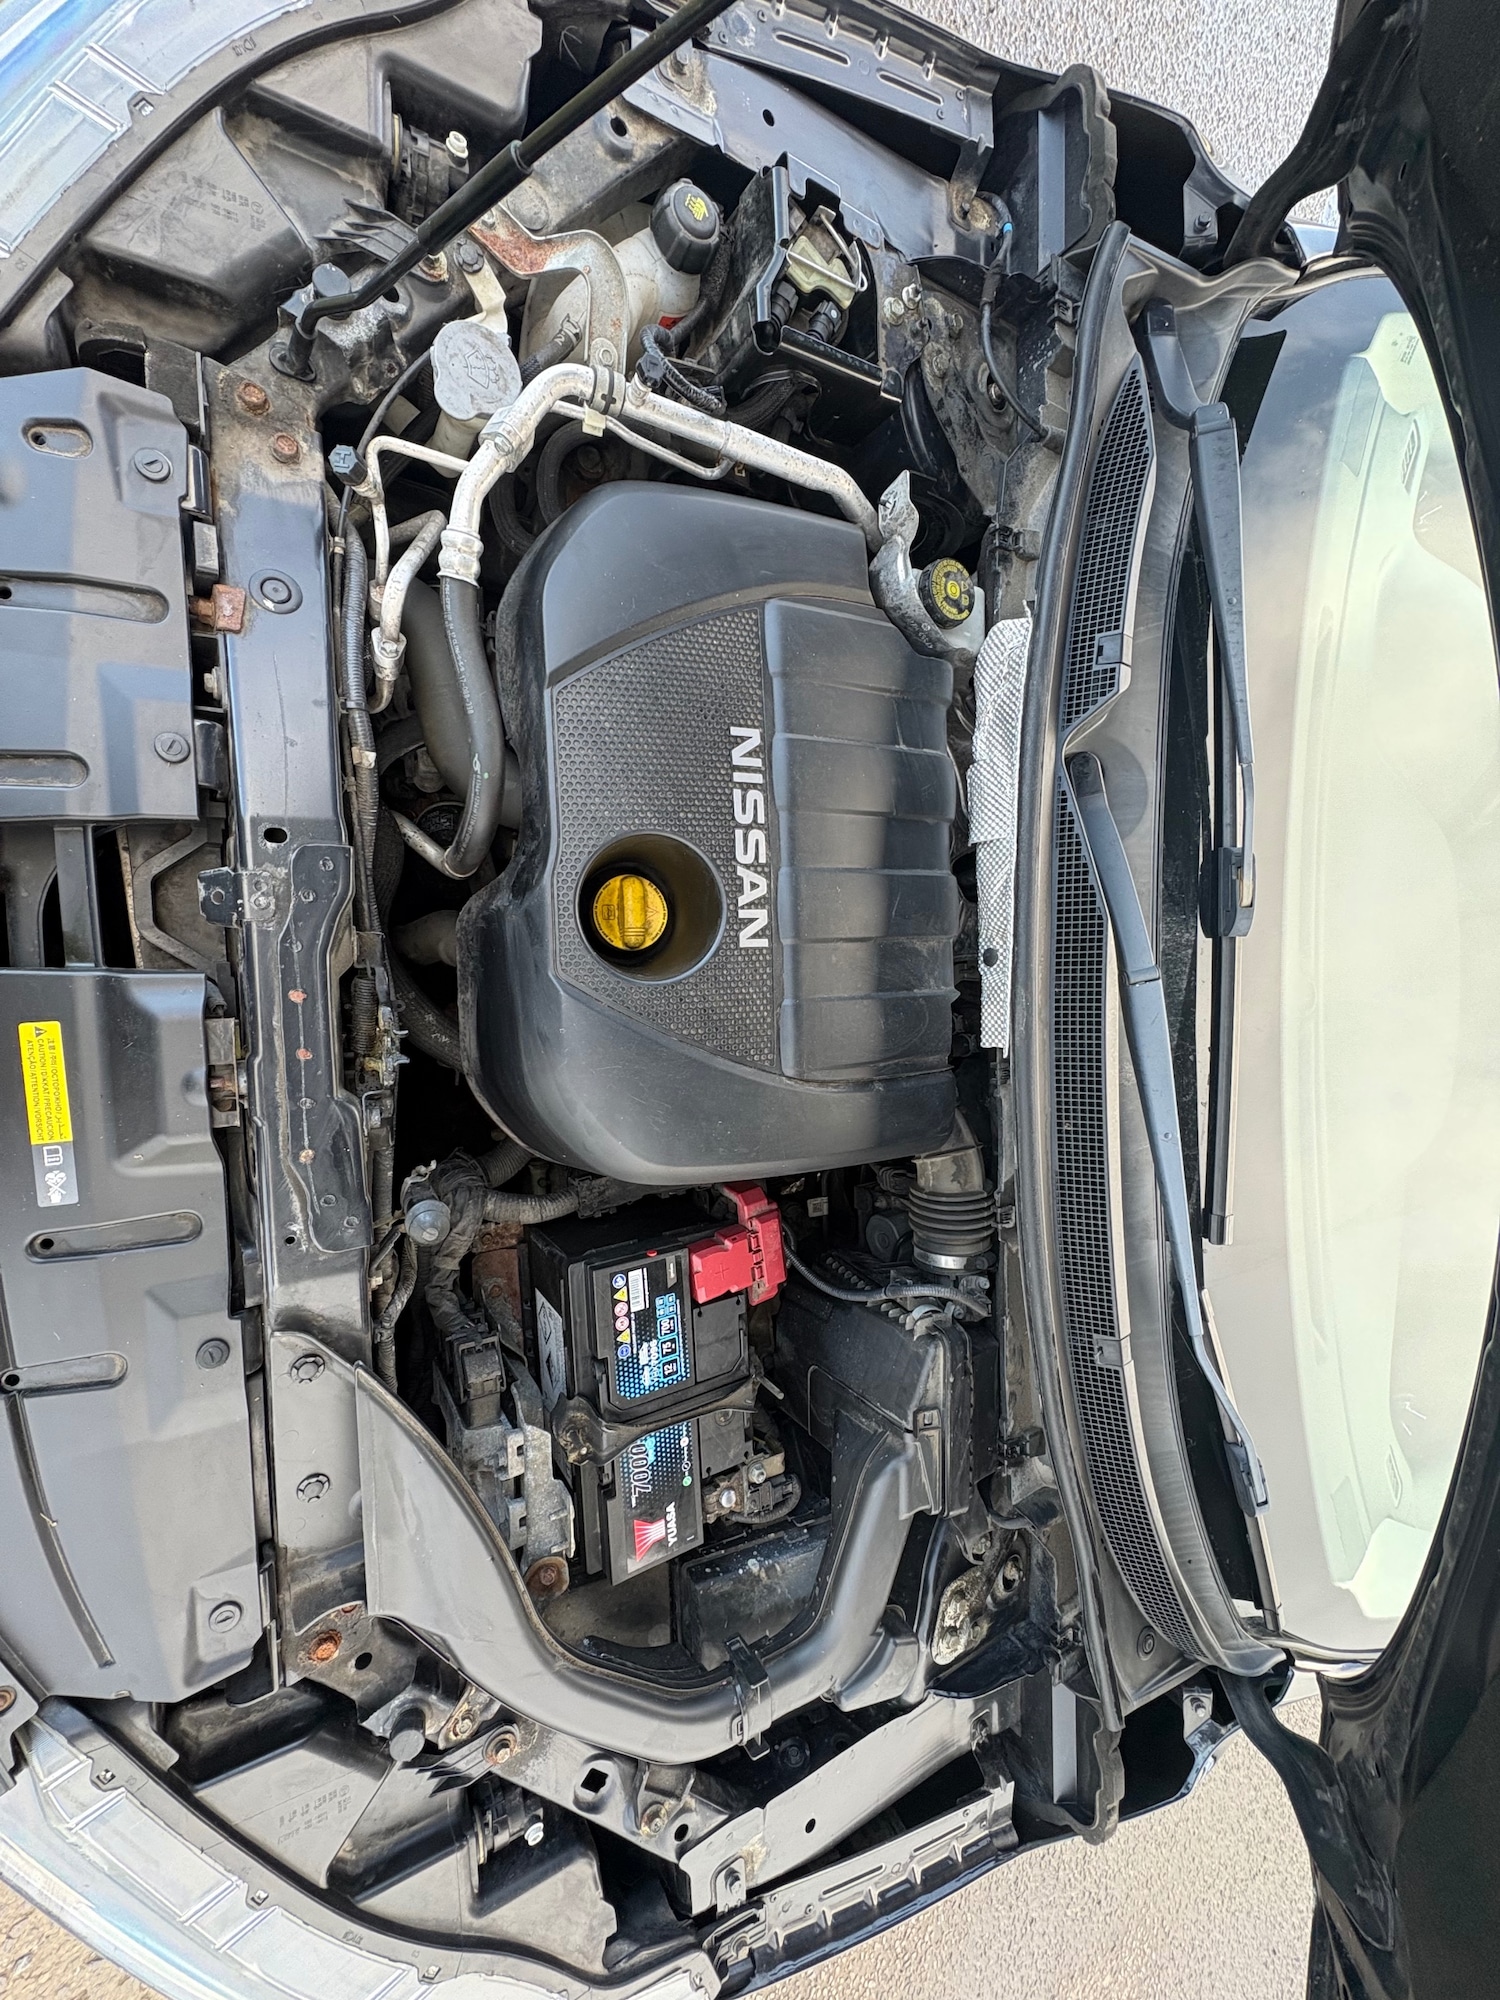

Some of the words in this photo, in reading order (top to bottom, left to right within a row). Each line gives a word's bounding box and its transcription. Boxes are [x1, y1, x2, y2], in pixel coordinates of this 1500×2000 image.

[730, 726, 769, 948] NISSAN
[660, 1318, 670, 1336] 700
[662, 1341, 671, 1355] 75
[663, 1363, 672, 1376] 12
[629, 1442, 652, 1497] 7000
[665, 1502, 677, 1548] YUASA
